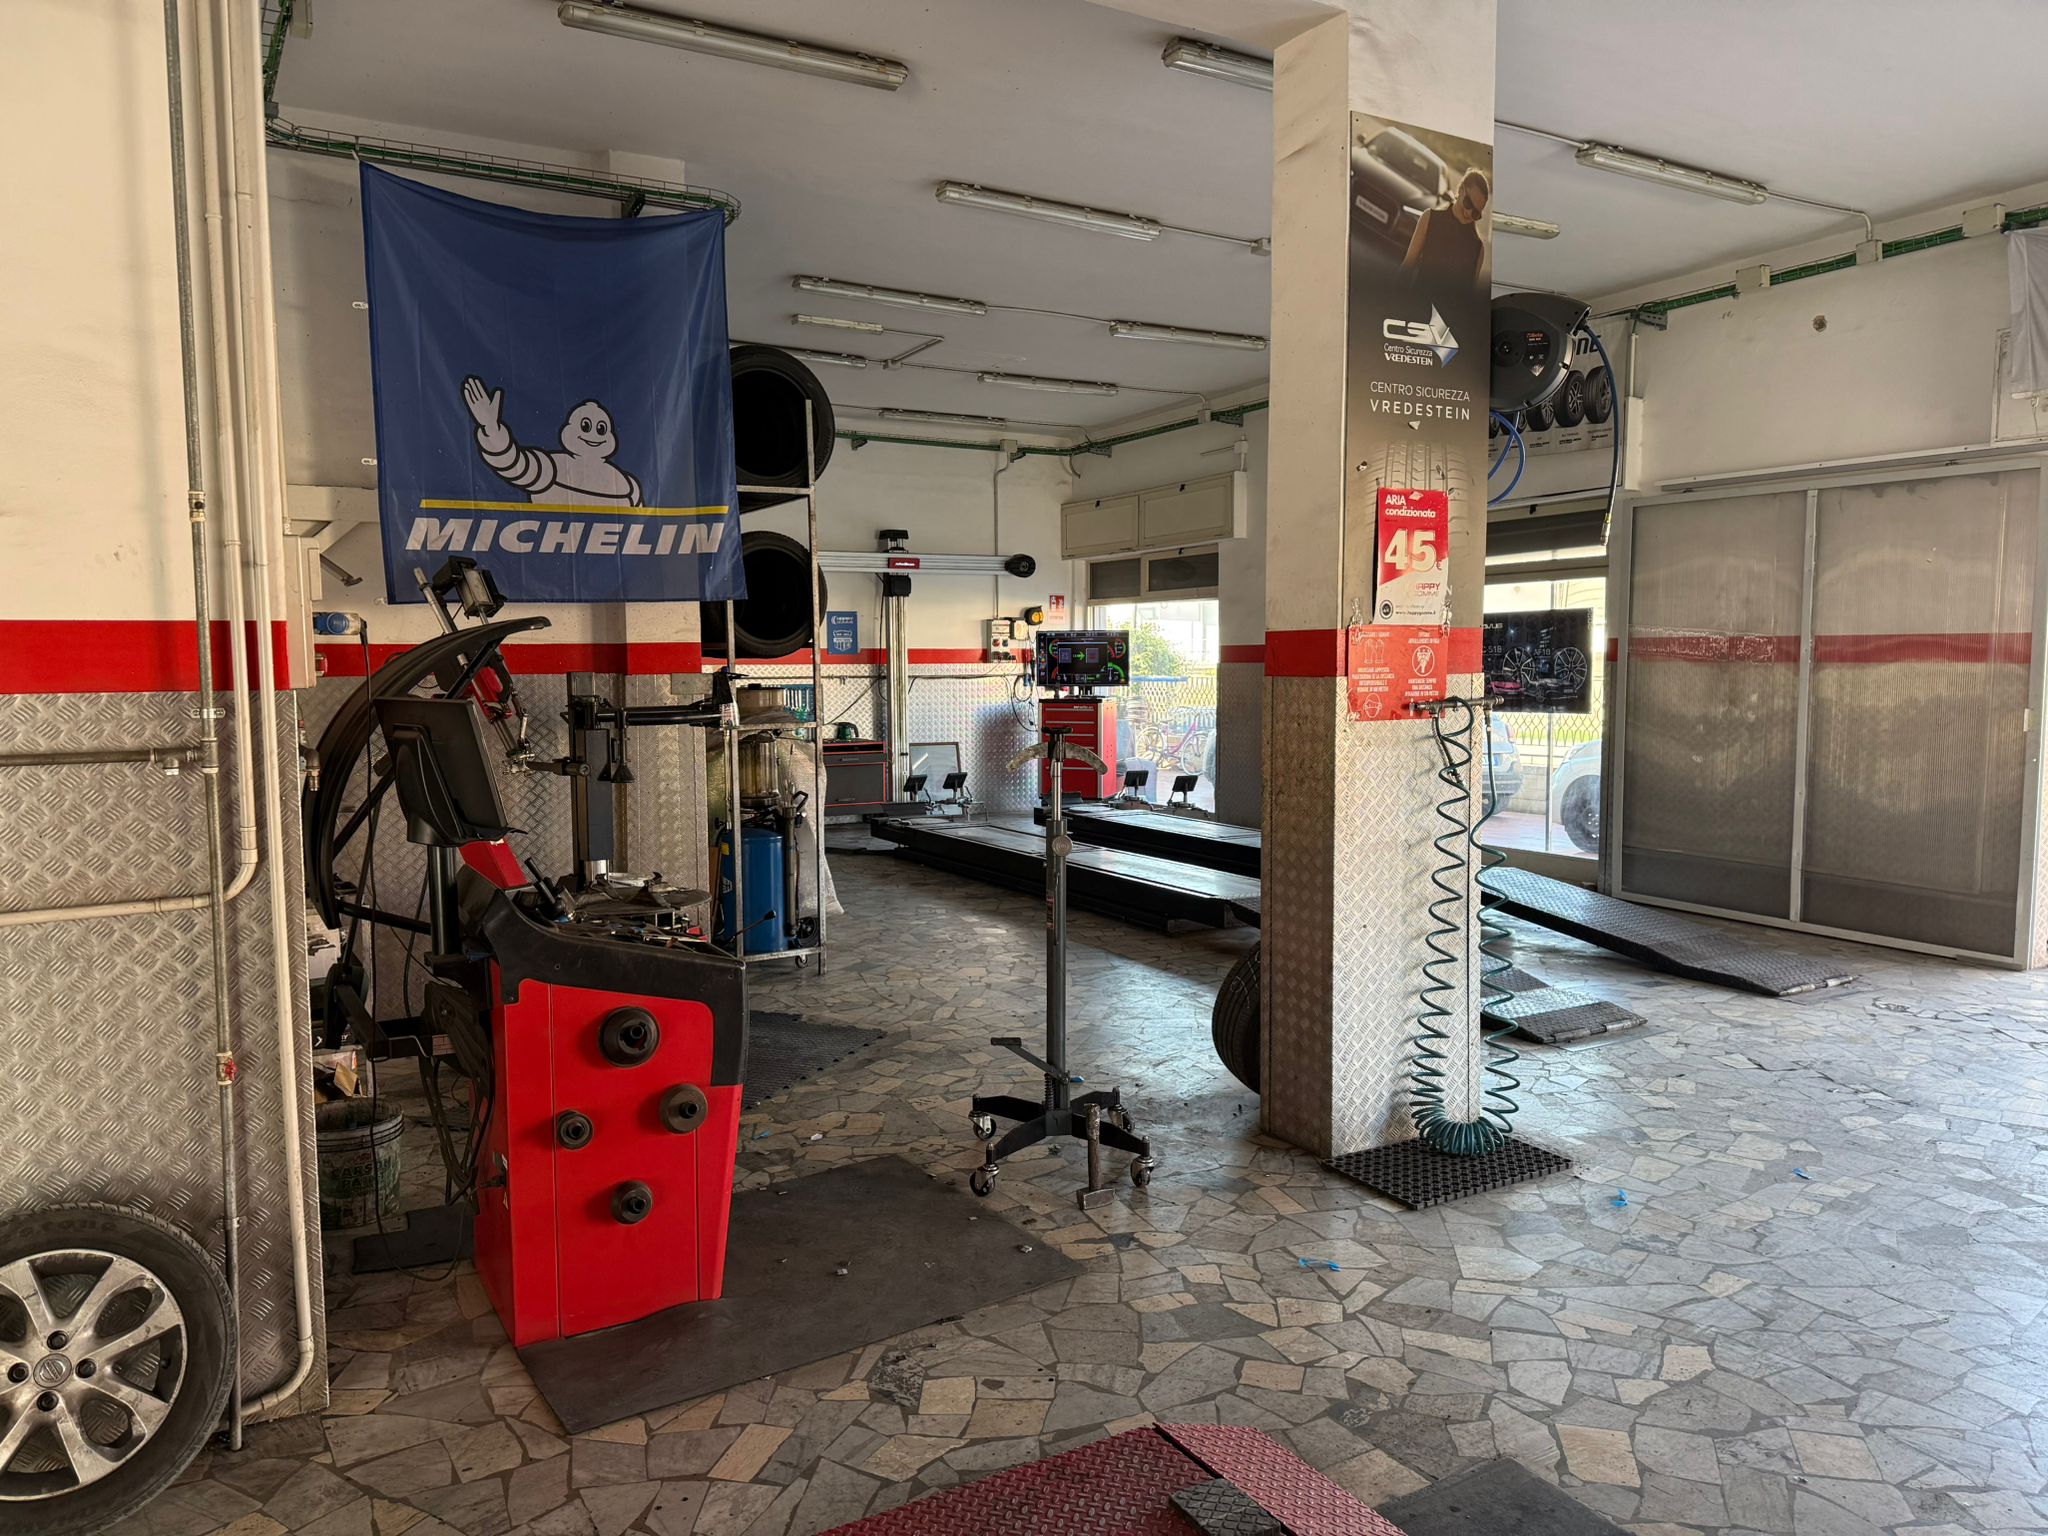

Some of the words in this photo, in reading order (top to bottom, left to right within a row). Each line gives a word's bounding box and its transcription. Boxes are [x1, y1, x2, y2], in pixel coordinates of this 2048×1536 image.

[1383, 343, 1404, 353] Centro
[1405, 345, 1433, 357] Sicurezza
[1384, 352, 1433, 367] VREDESTEIN
[1370, 381, 1413, 396] CENTRO
[1415, 386, 1471, 402] SICUREZZA
[1370, 398, 1470, 421] VREDESTEIN
[1385, 494, 1406, 505] ARIA
[1385, 505, 1436, 518] condizionata
[405, 517, 725, 556] MICHELIN
